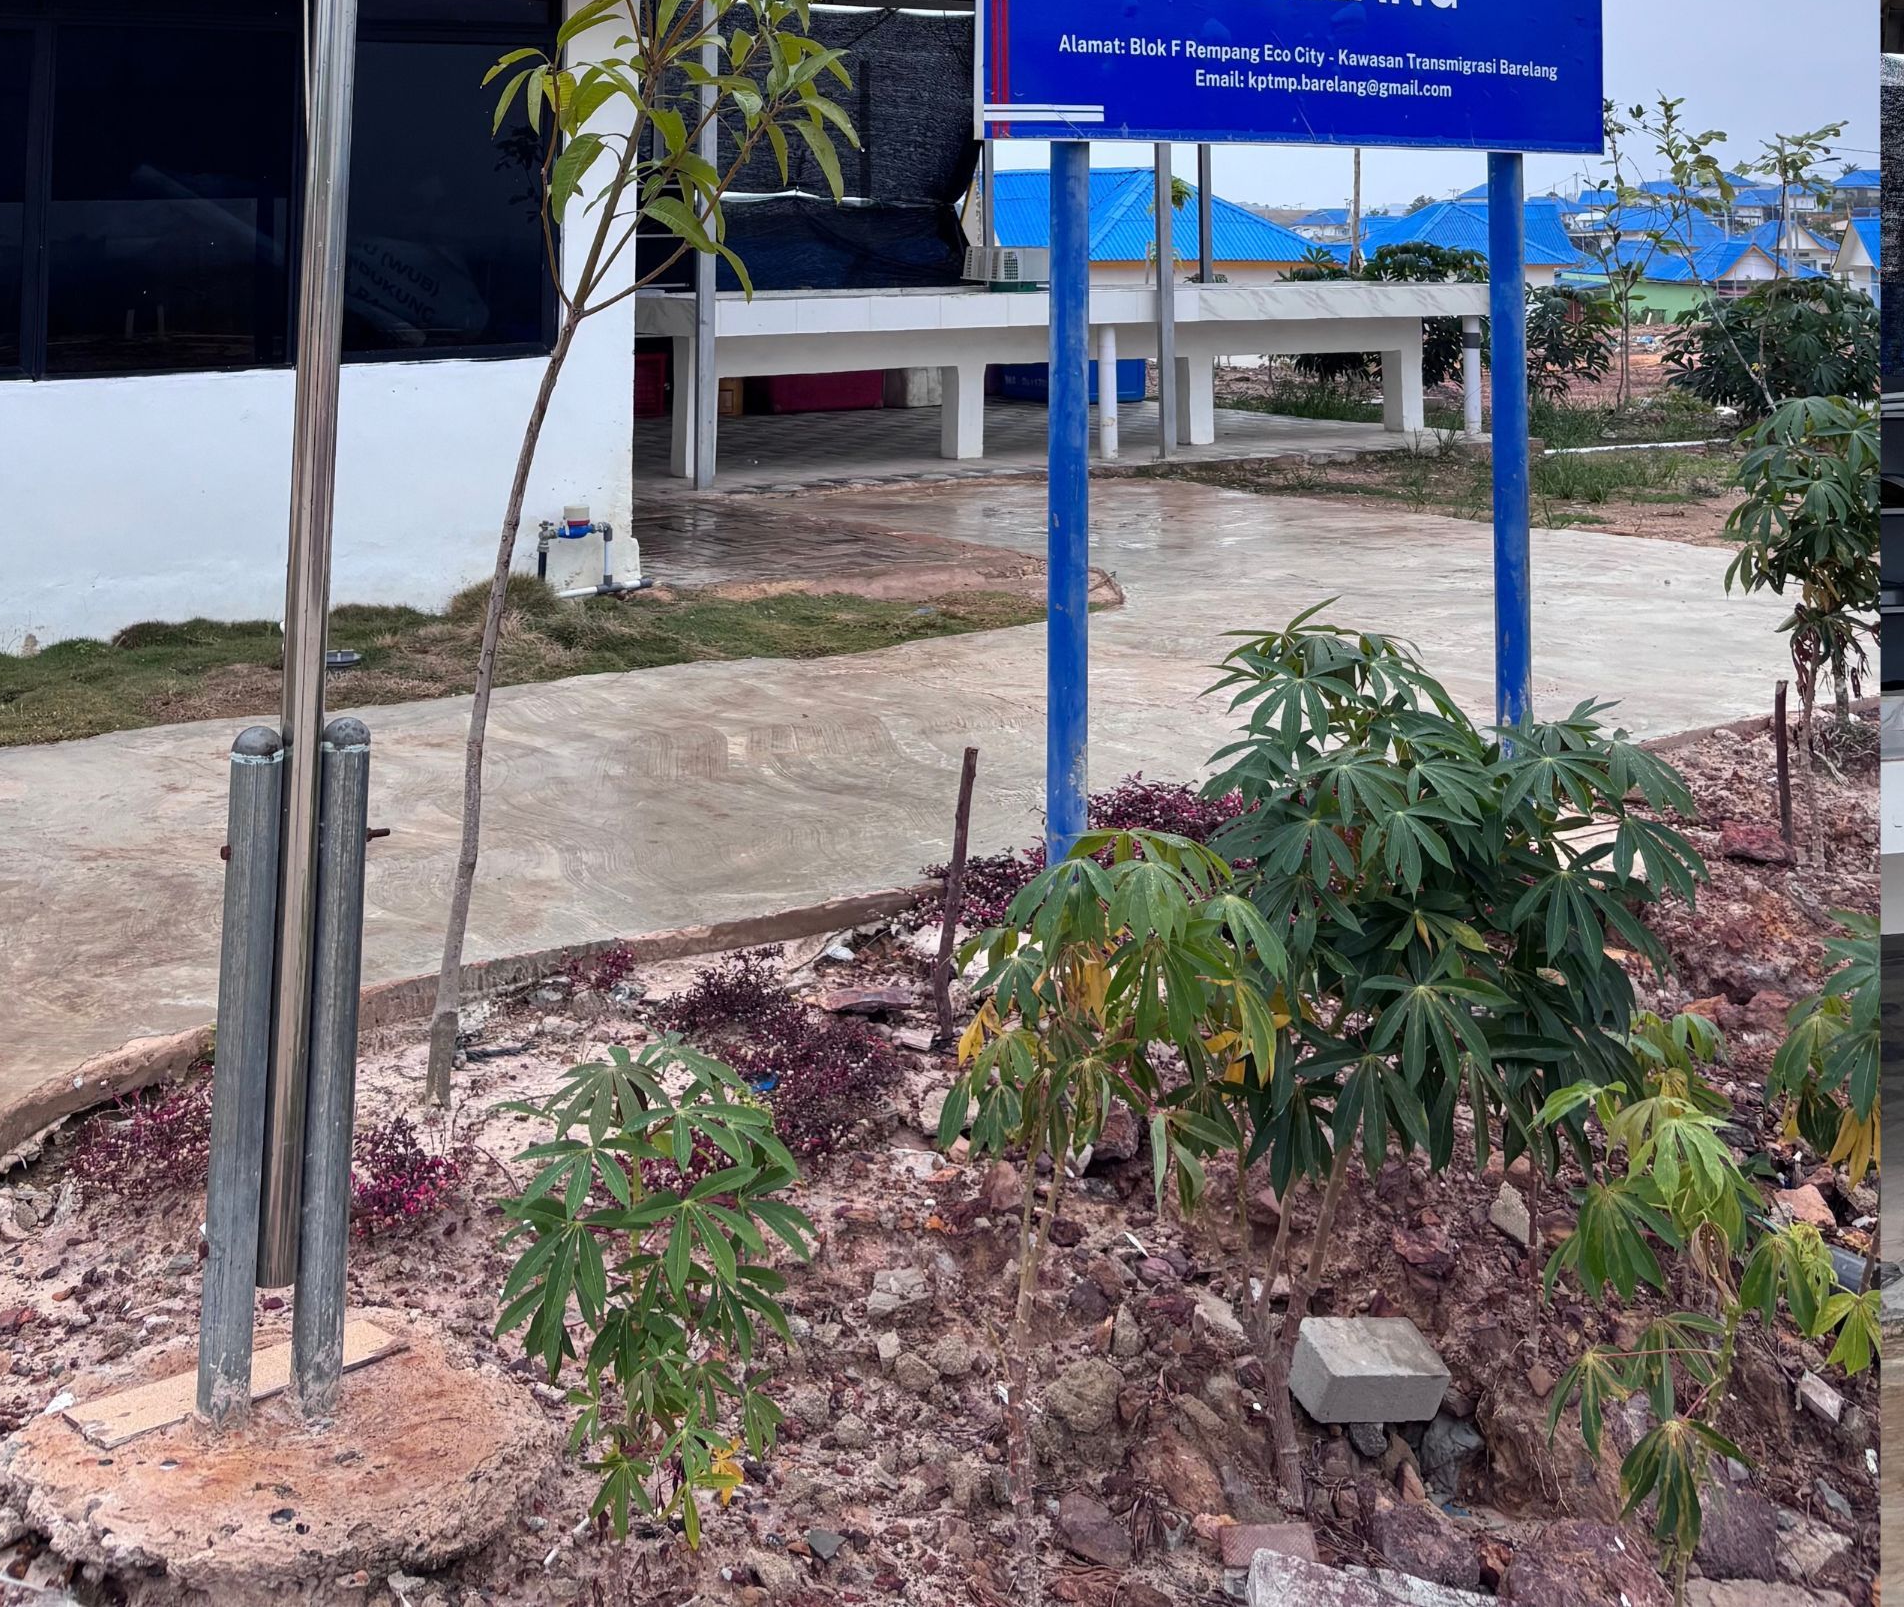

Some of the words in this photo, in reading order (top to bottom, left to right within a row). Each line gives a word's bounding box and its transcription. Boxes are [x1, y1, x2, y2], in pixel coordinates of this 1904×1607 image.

[1059, 34, 1125, 54] Alamat:
[1130, 38, 1166, 56] Blok
[1171, 40, 1181, 57] F
[1185, 40, 1260, 63] Rempang
[1264, 44, 1291, 61] Eco
[1295, 46, 1325, 67] City
[1338, 49, 1403, 69] Kawasan
[1406, 53, 1496, 75] Transmigrasi
[1499, 59, 1558, 81] Barelang
[1195, 69, 1244, 88] Email:
[1248, 71, 1452, 97] kptmp.barelang@gmail.com
